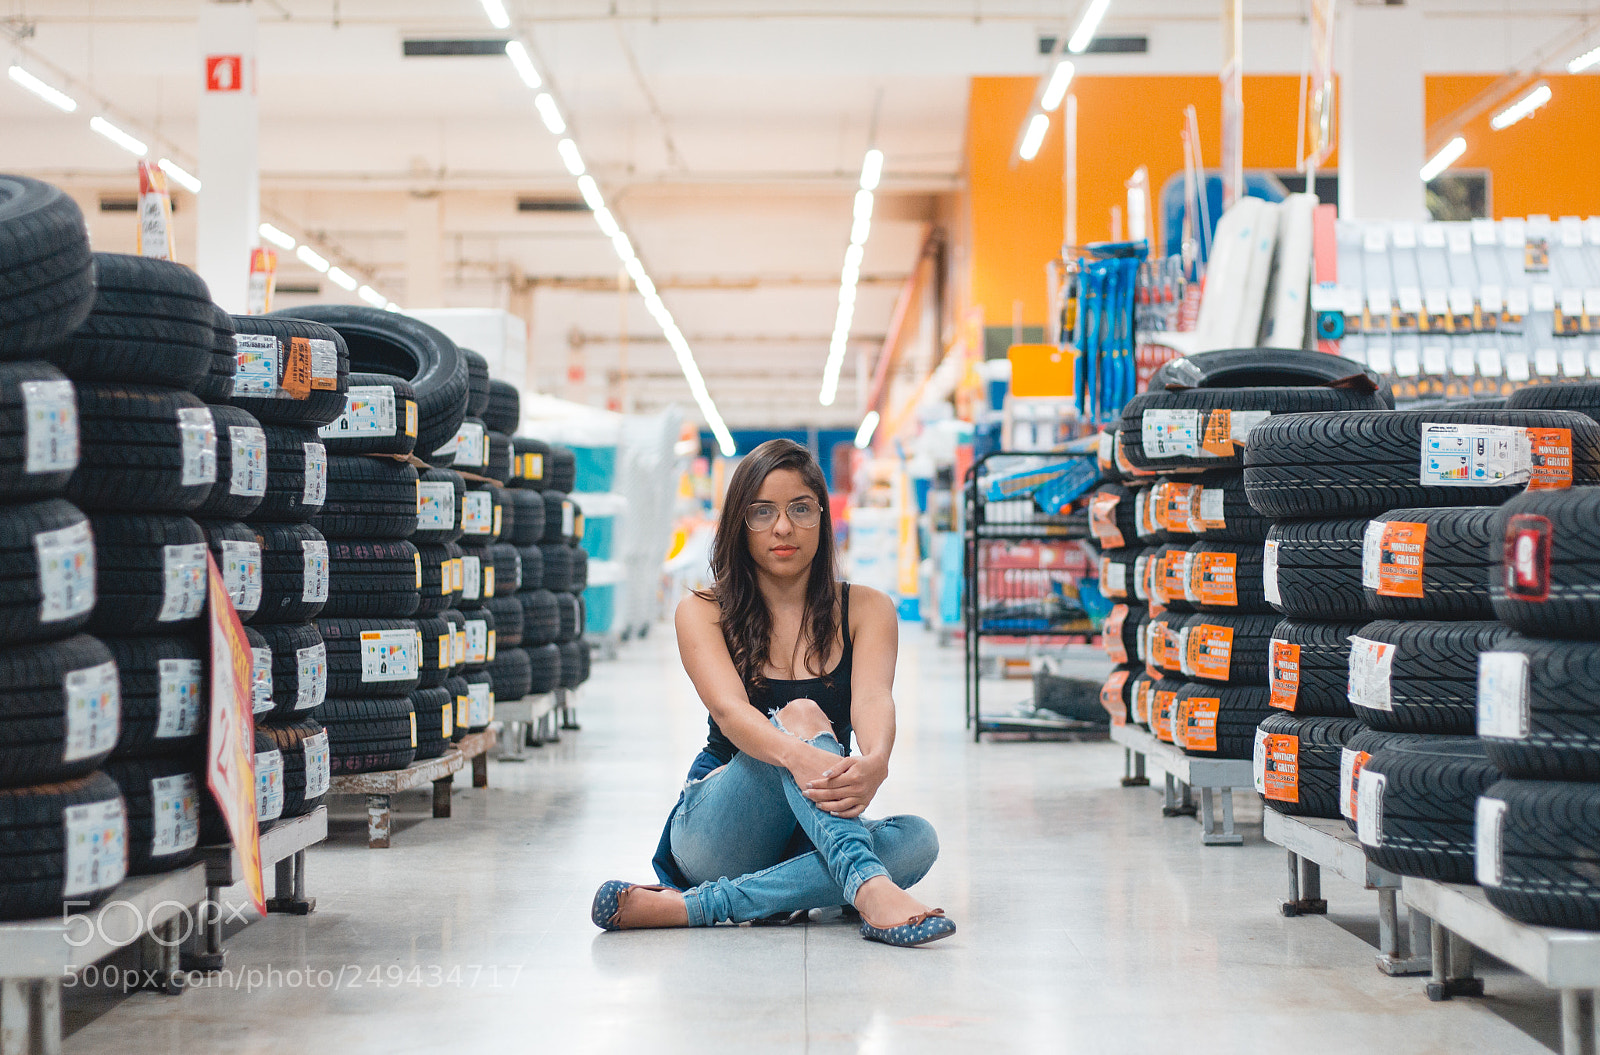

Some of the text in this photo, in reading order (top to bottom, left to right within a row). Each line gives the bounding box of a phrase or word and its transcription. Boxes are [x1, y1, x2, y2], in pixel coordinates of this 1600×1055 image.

[1538, 445, 1569, 455] MONTAGEM
[1547, 456, 1569, 467] GRÁTIS
[1391, 542, 1420, 553] MONTAGEM
[1396, 553, 1419, 566] GRÁTIS
[1278, 660, 1298, 670] MONTAGEM
[1282, 670, 1298, 682] GRÁTIS
[1273, 751, 1295, 762] MONTAGEM
[1277, 761, 1295, 773] GRÁTIS
